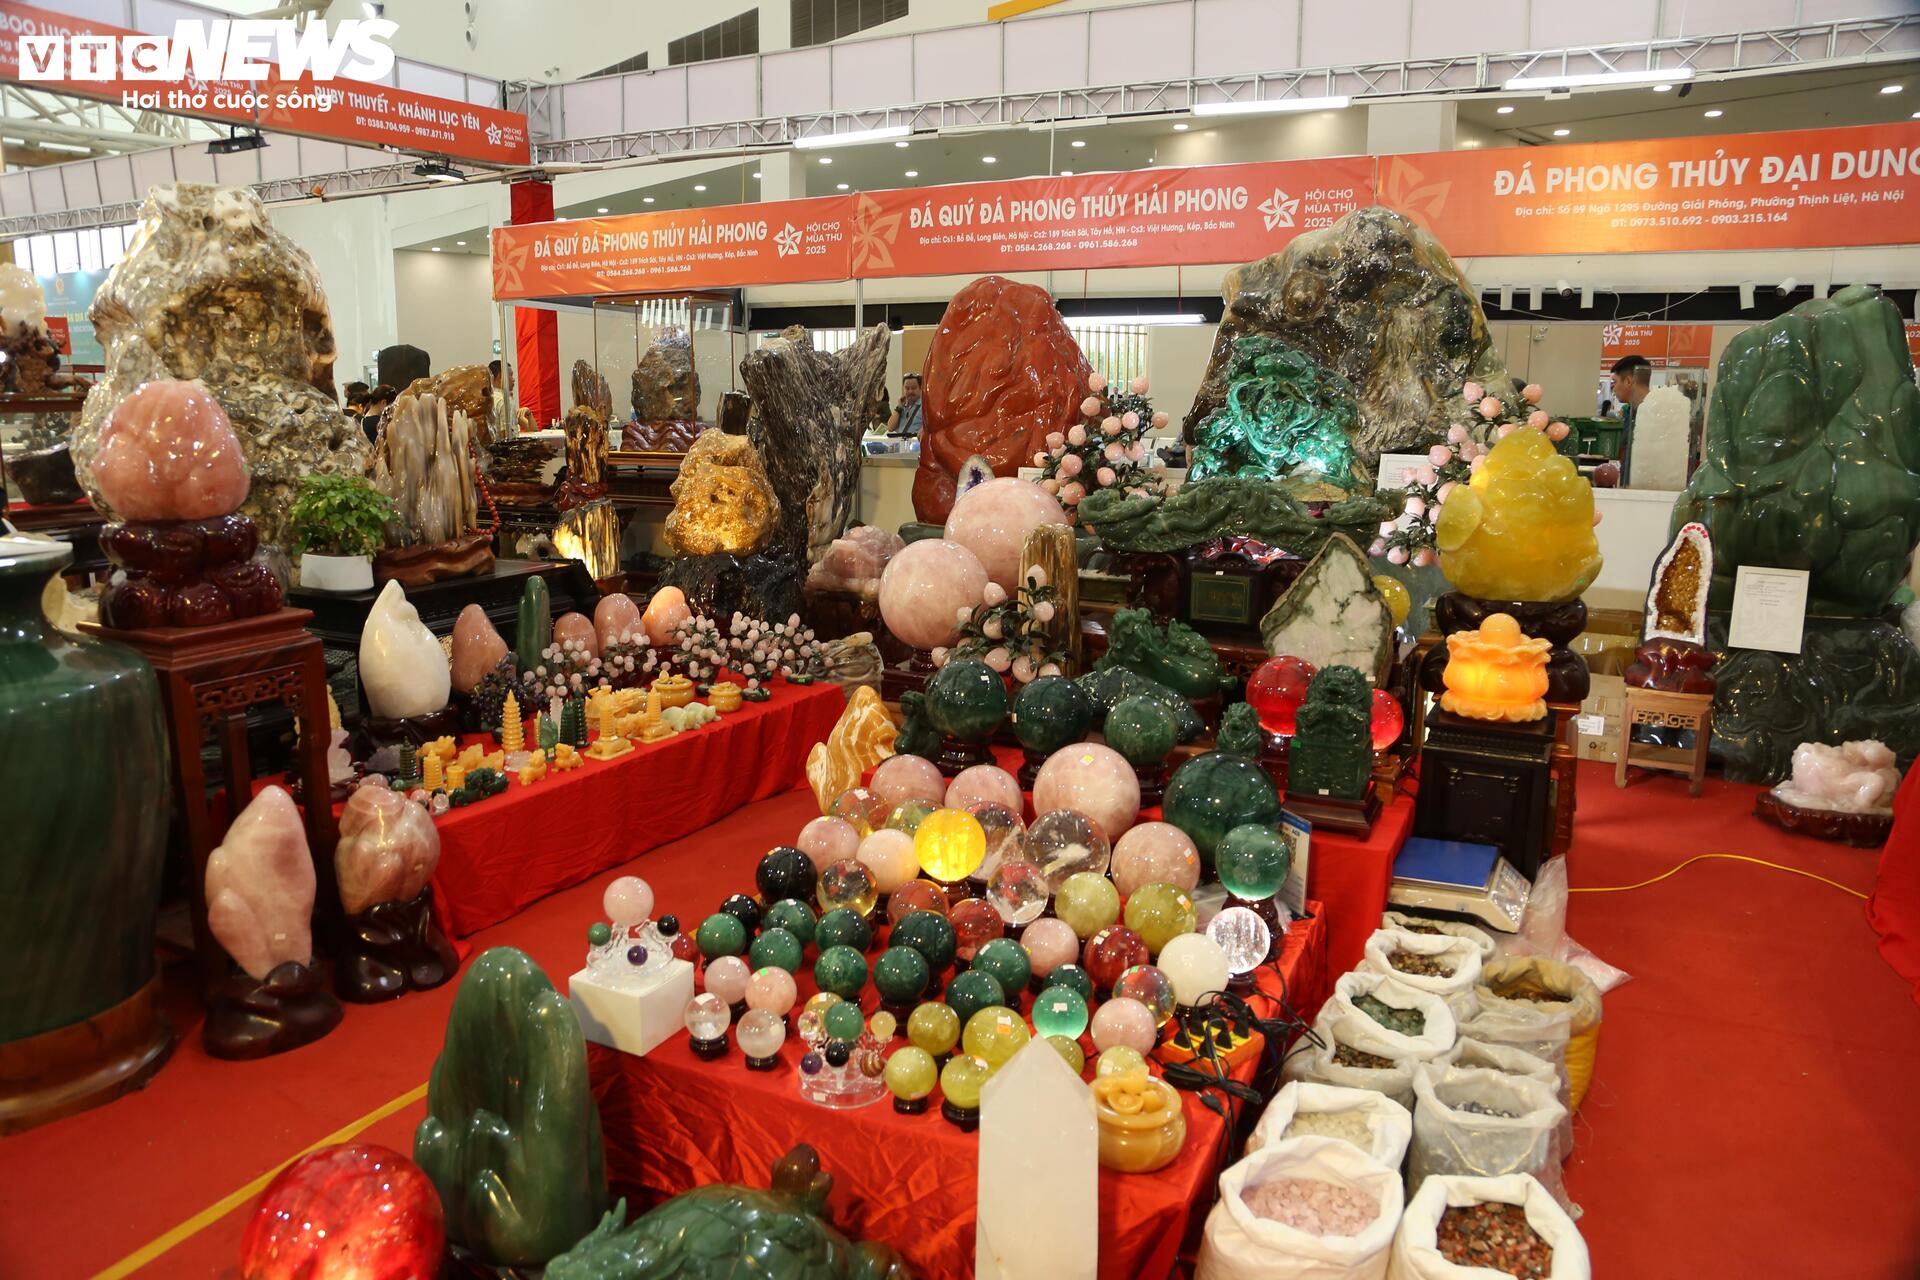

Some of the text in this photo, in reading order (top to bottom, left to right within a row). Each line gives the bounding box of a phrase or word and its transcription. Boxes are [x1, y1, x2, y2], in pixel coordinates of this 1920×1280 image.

[347, 93, 389, 114] THUYẾT
[398, 101, 437, 122] KHÁNH
[439, 110, 459, 129] LỤC
[461, 111, 480, 131] YÊN
[415, 126, 455, 141] 0987.871.918
[1494, 160, 1536, 195] ĐÁ
[1546, 162, 1659, 193] PHONG
[1668, 148, 1751, 188] THỦY
[1760, 153, 1820, 190] ĐẠI
[1305, 188, 1354, 203] HỘI CHỢ
[910, 183, 1248, 228] ĐÁ QUÝ ĐÁ PHONG THỦY HẢI PHONG
[1304, 202, 1357, 214] MÙA THU
[1515, 207, 1532, 218] Địa
[1615, 202, 1639, 212] 1295
[1642, 199, 1678, 212] Đường
[1682, 198, 1705, 210] Giải
[1708, 197, 1747, 211] Phóng,
[1750, 195, 1795, 208] Phường
[1798, 194, 1829, 207] Thịnh
[1833, 192, 1857, 206] Liệt,
[1861, 190, 1879, 202] Hà
[1883, 189, 1905, 203] Nội
[807, 221, 840, 233] HỘI CHỢ
[1304, 217, 1333, 228] 2025
[1629, 215, 1702, 227] 0973.510.692
[1711, 212, 1788, 224] 0903.215.164
[534, 219, 768, 258] ĐÁ QUÝ ĐÁ PHONG THỦY HẢI PHONG
[825, 233, 843, 241] THU
[977, 234, 991, 242] Long
[1115, 226, 1125, 234] HN
[1219, 220, 1235, 229] Ninh
[806, 245, 826, 254] 2025
[1015, 242, 1071, 252] 0584.268.268
[1078, 239, 1138, 249] 0961.586.268
